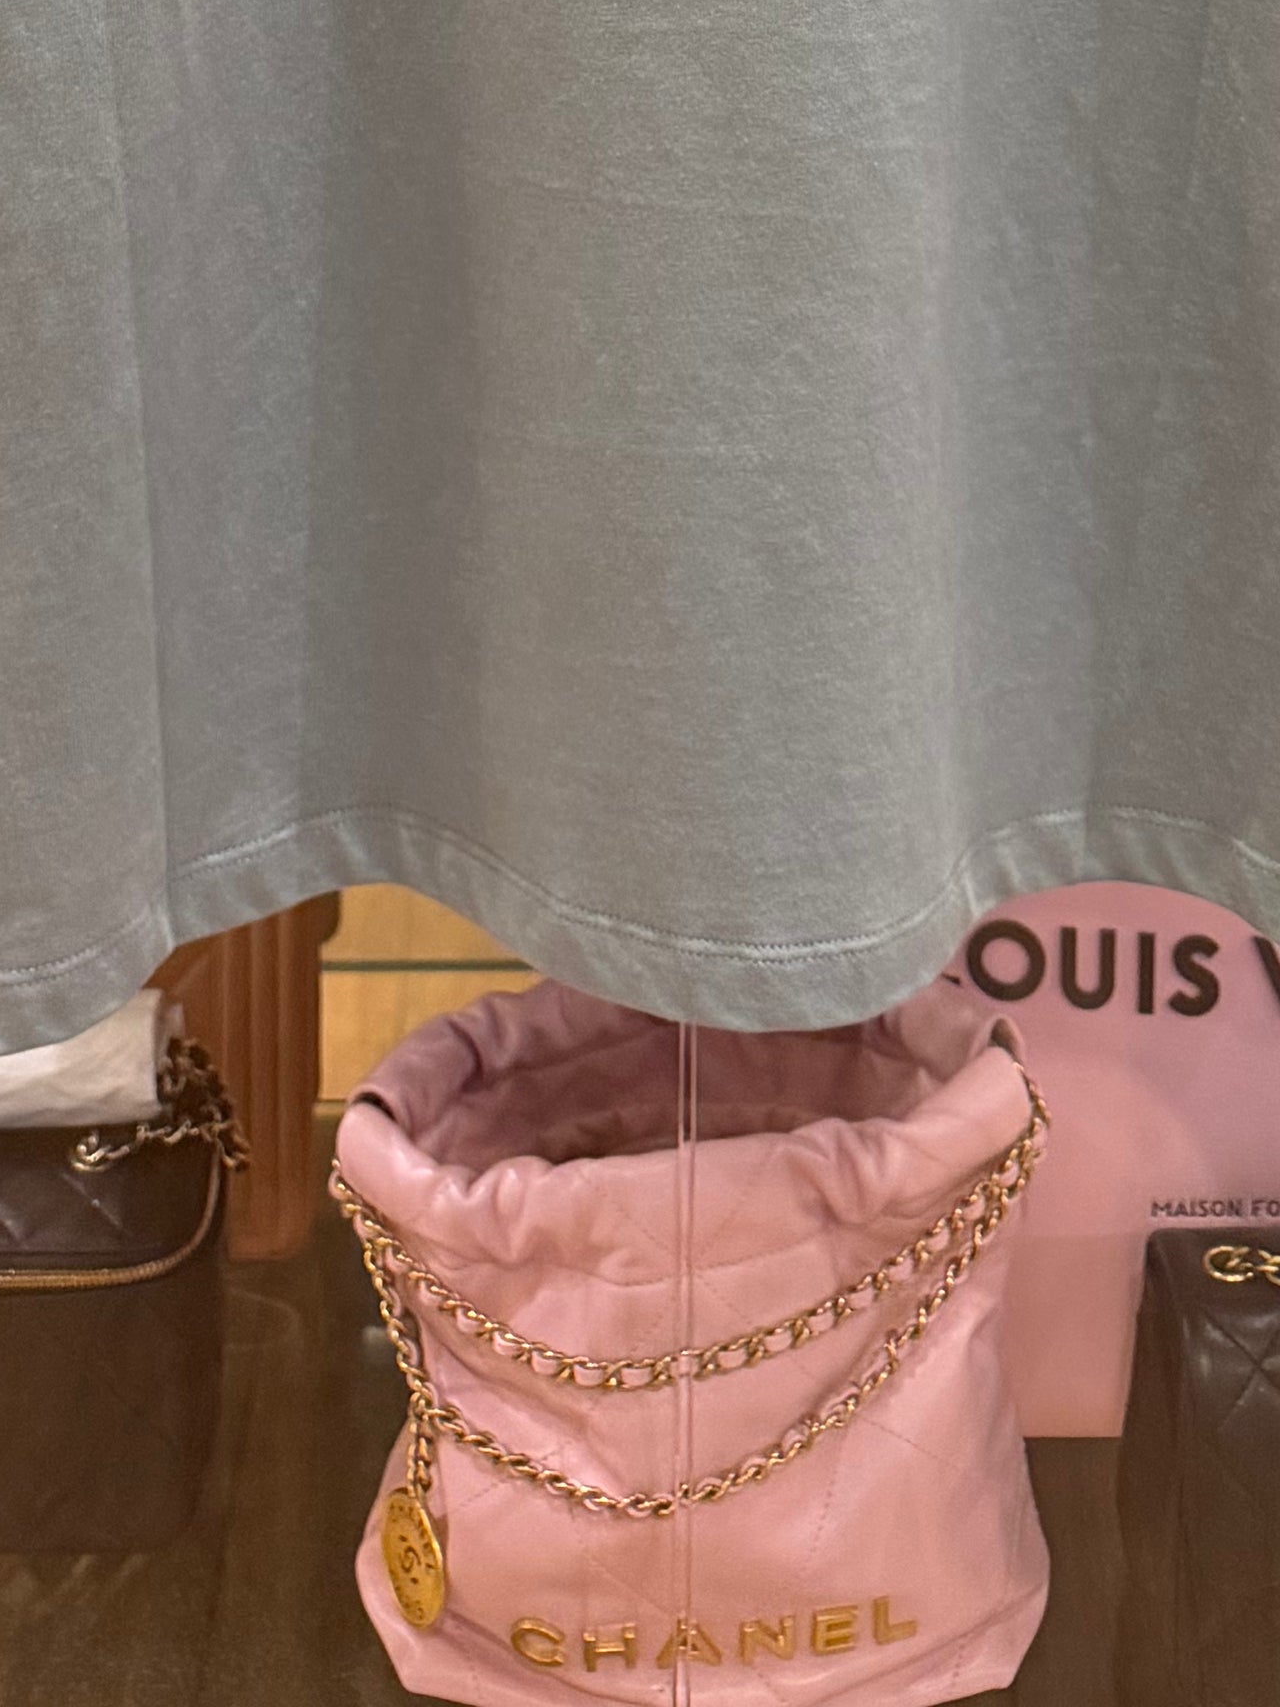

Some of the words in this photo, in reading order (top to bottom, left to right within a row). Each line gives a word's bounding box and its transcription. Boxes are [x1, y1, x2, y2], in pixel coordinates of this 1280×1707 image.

[942, 918, 1221, 1018] OUIS
[1150, 1198, 1243, 1218] MAISON
[509, 1595, 919, 1672] CHANEL
